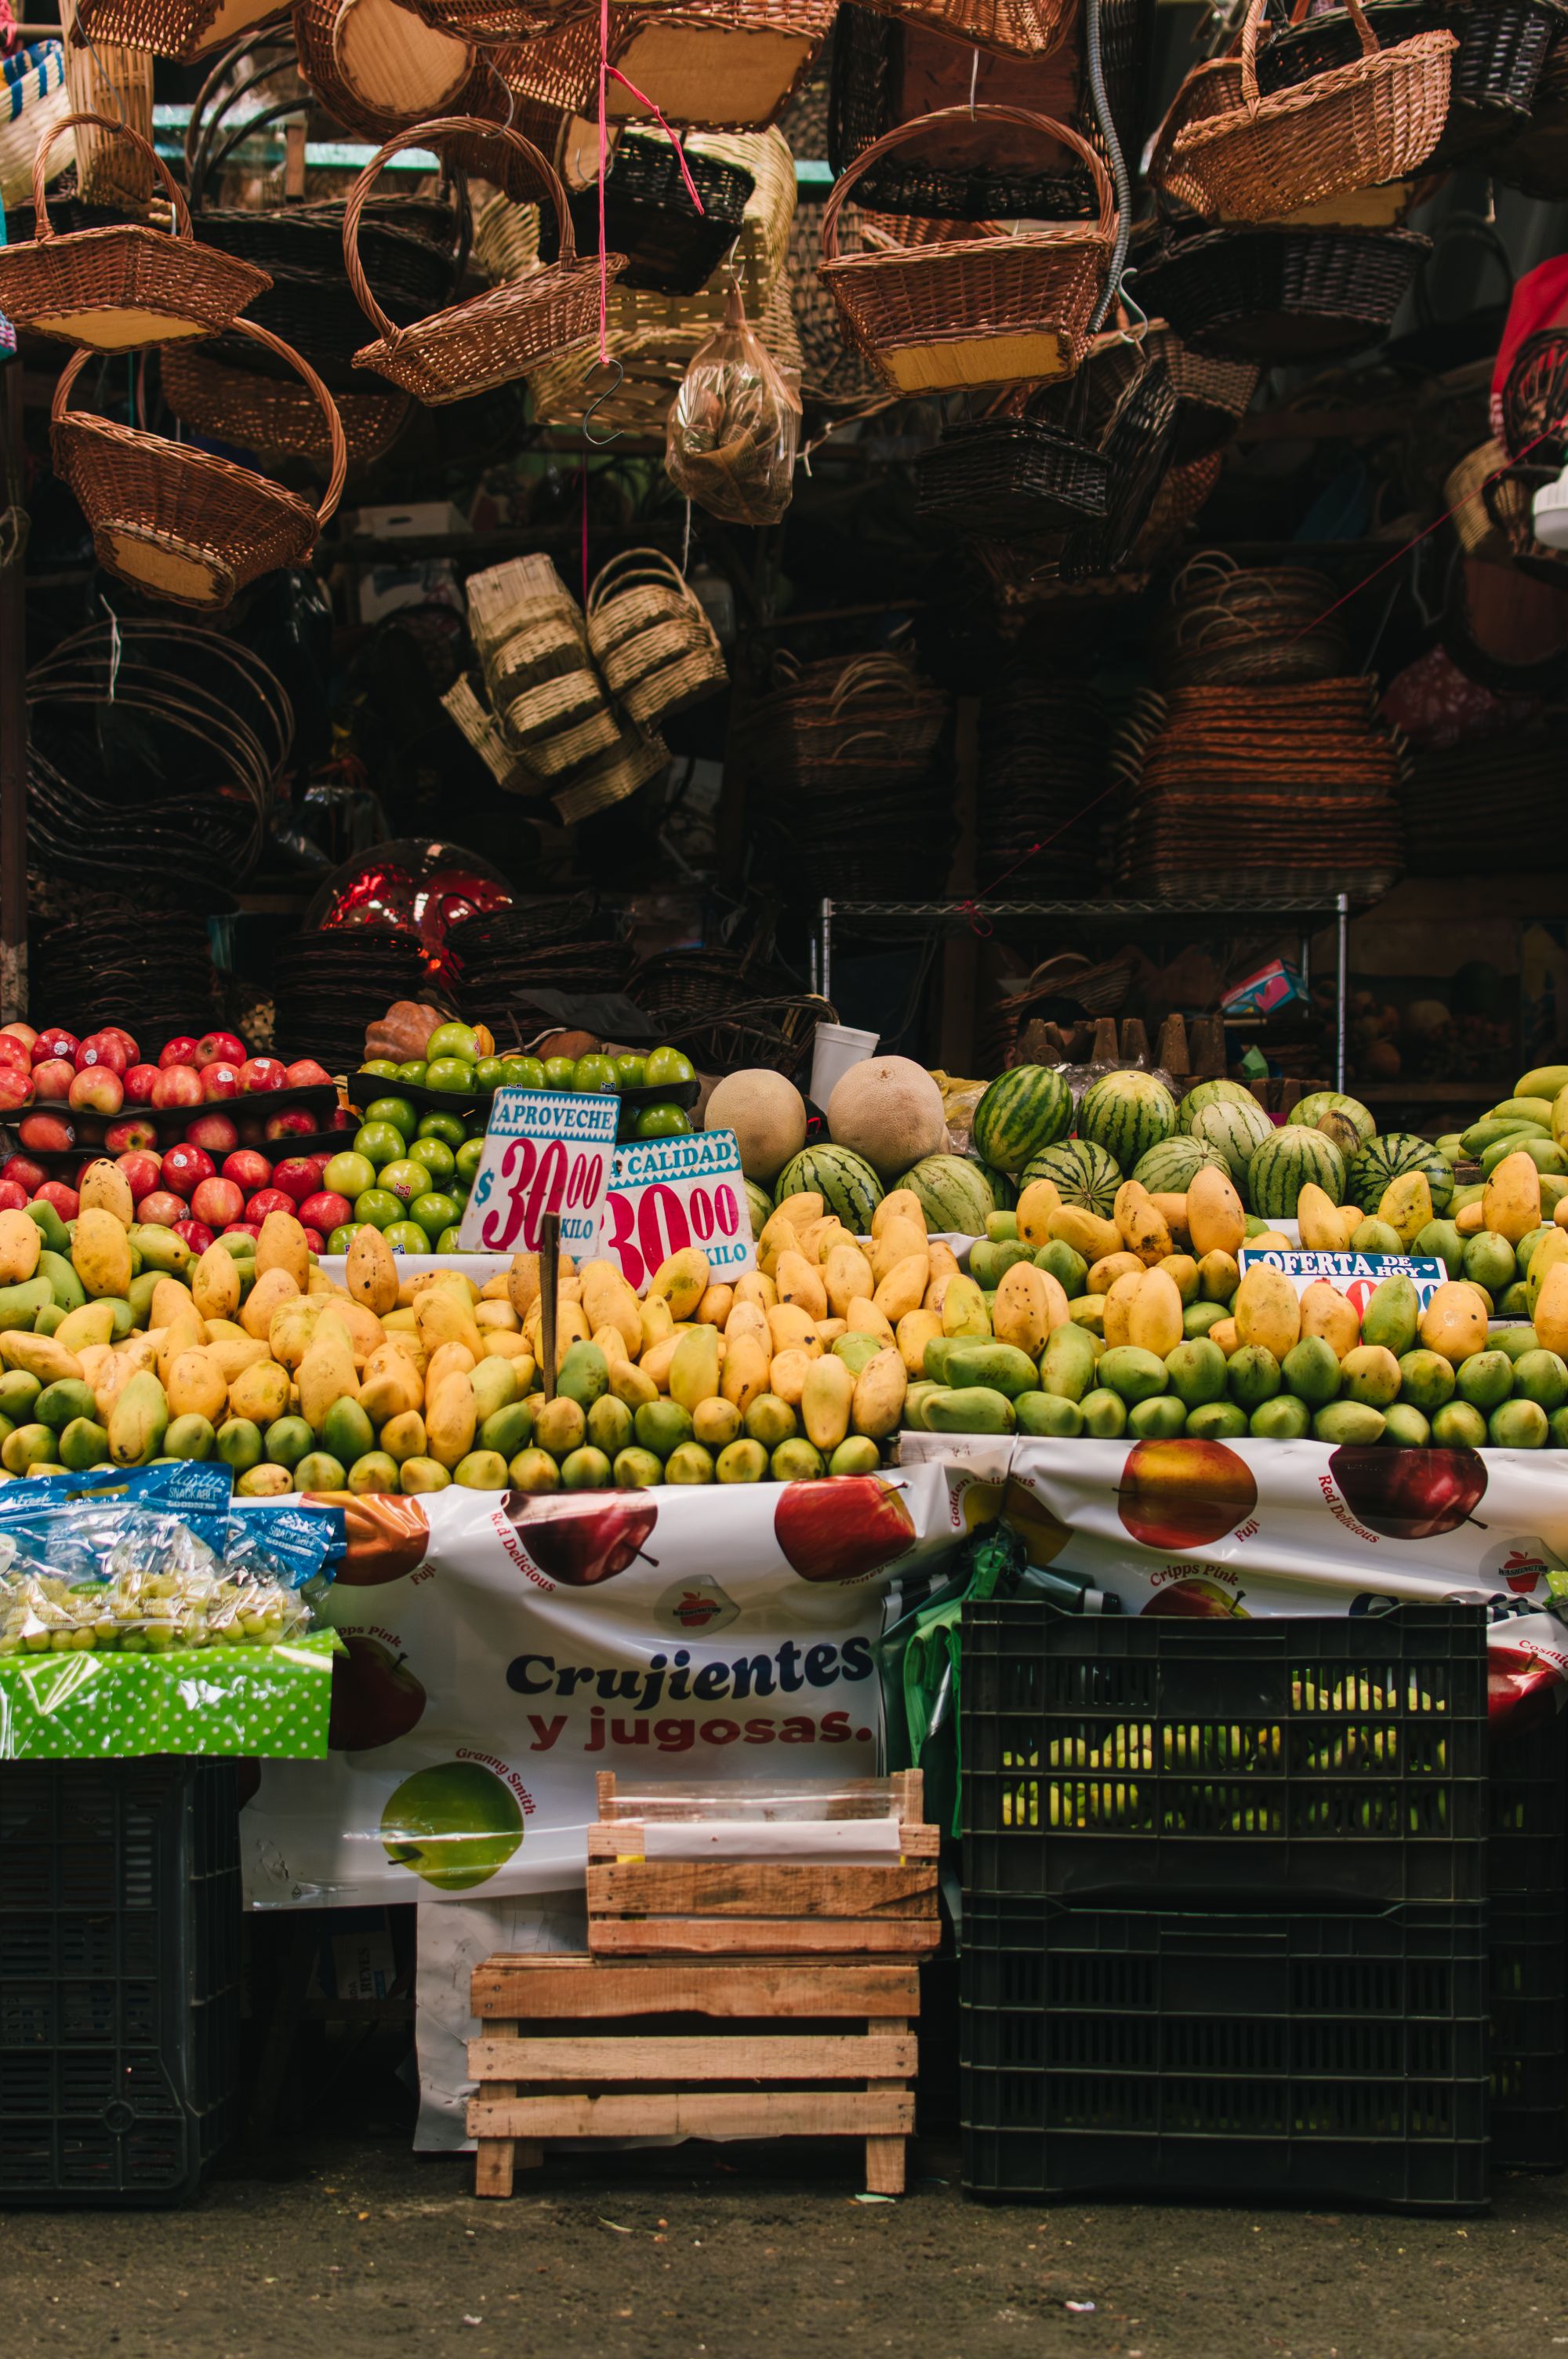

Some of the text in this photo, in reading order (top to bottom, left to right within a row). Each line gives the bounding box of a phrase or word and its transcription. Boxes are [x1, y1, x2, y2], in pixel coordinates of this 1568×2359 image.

[496, 1103, 613, 1130] APROVECHE
[628, 1142, 731, 1176] CALIDAD
[560, 1217, 593, 1240] KILO
[1261, 1252, 1374, 1276] OFERTA
[1375, 1266, 1421, 1278] HOY
[1381, 1256, 1412, 1267] DE
[949, 1478, 971, 1527] Golden
[1319, 1474, 1380, 1543] Red Delicious
[1234, 1518, 1260, 1543] Fuji
[491, 1511, 557, 1592] Red Delicious
[410, 1562, 436, 1586] Fuji
[1149, 1564, 1239, 1587] Cripps Pink
[368, 1625, 402, 1648] Pink
[506, 1636, 874, 1711] Crujientes
[527, 1705, 873, 1753] y jugosas.
[456, 1747, 536, 1816] Granny Smith
